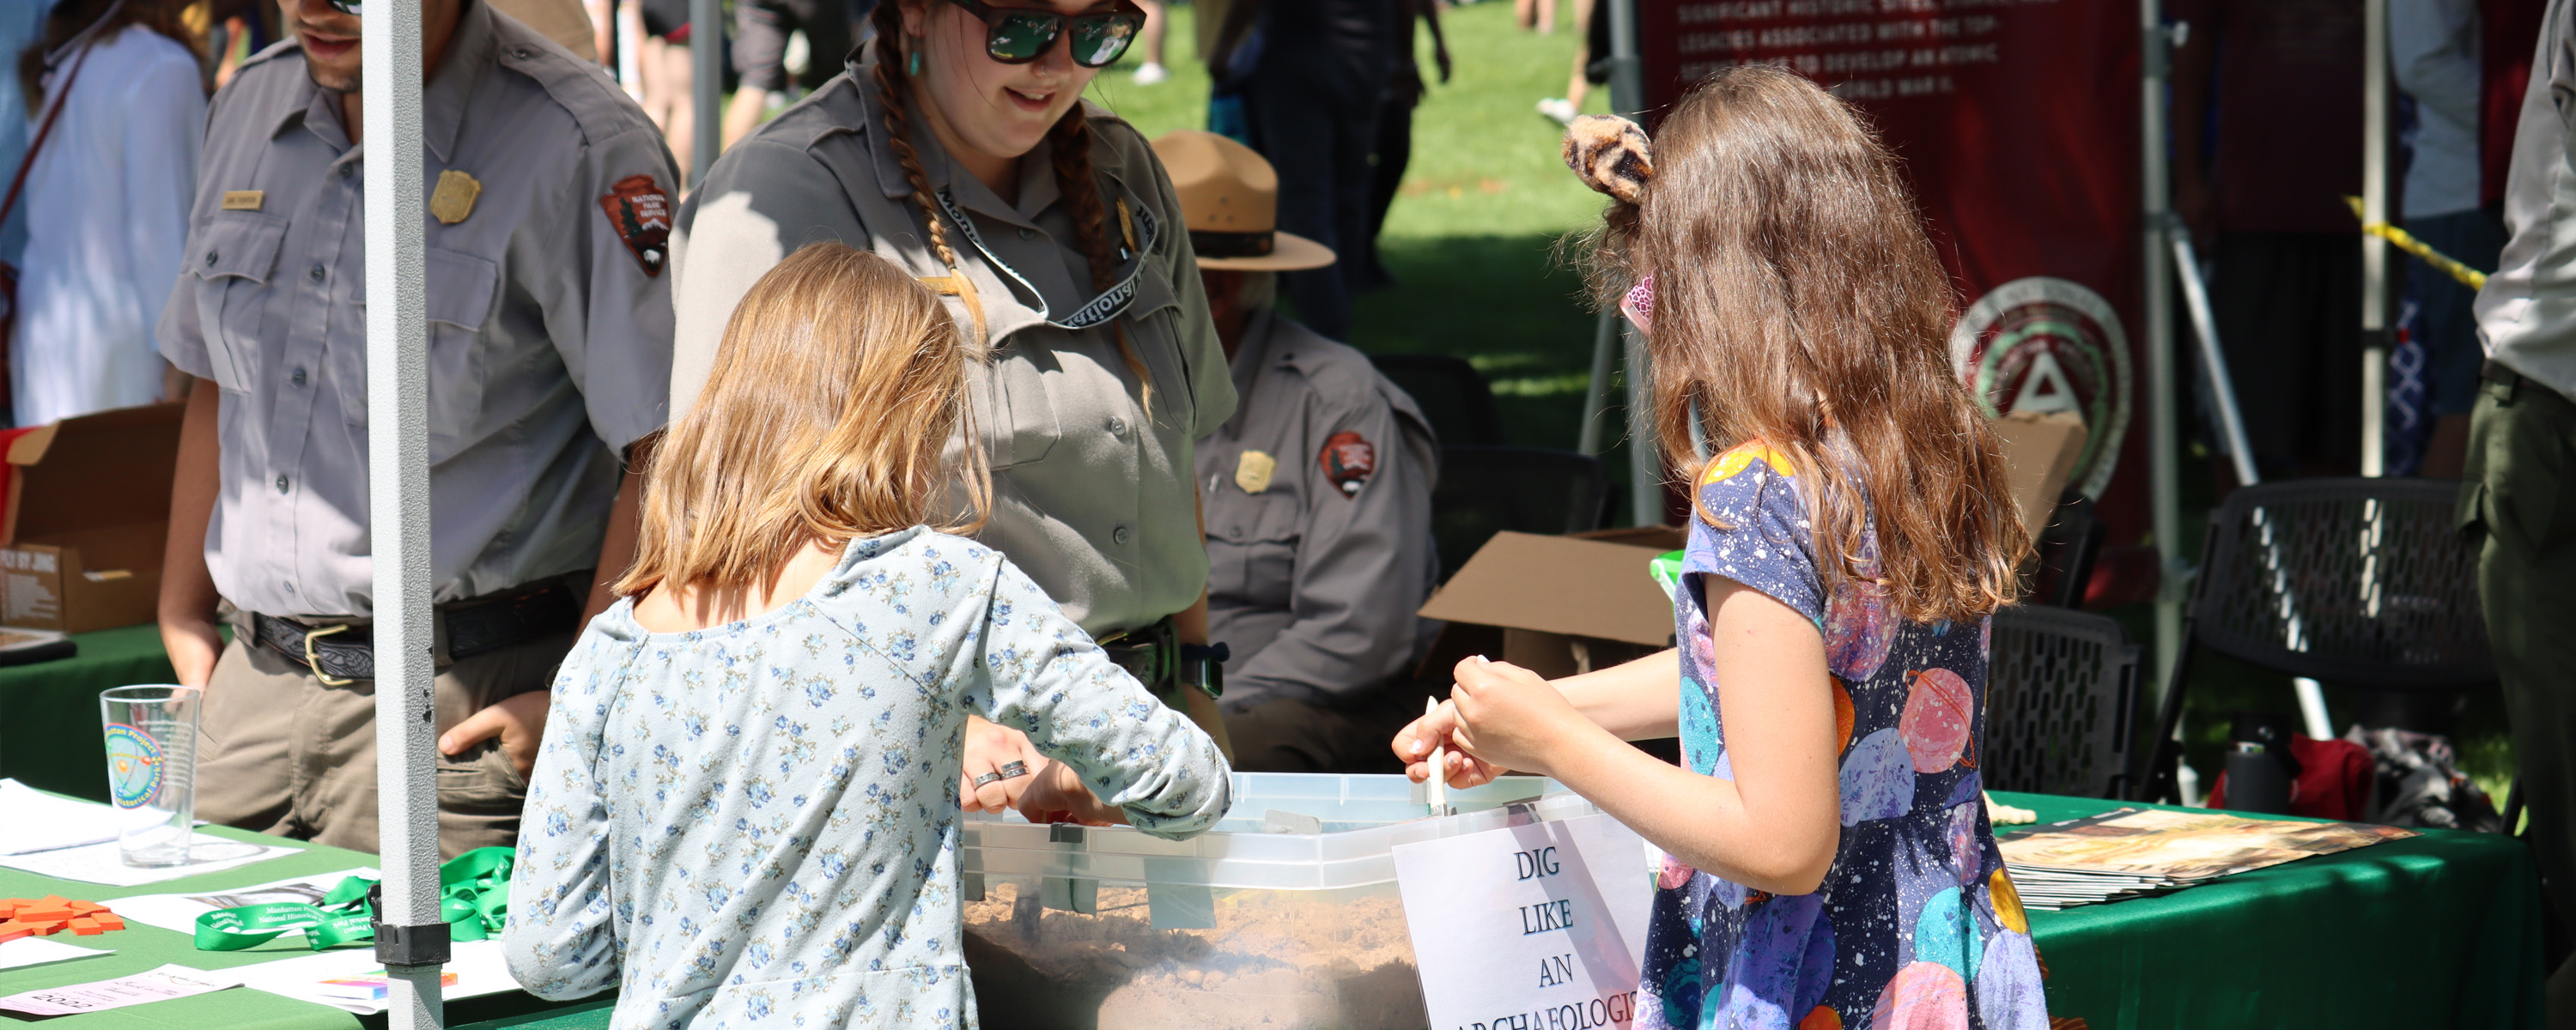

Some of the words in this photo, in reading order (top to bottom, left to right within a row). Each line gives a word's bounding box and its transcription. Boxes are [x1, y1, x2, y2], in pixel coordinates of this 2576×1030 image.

[632, 194, 665, 203] NATIONAL
[640, 209, 666, 218] SERVICE
[128, 730, 156, 754] Project
[149, 766, 161, 788] Park
[1514, 846, 1560, 881] DIG
[258, 914, 286, 924] National
[287, 912, 318, 921] Historical
[266, 906, 301, 914] Manhattan
[1519, 899, 1573, 936] LIKE
[1539, 954, 1573, 987] AN
[30, 994, 93, 1009] 2022
